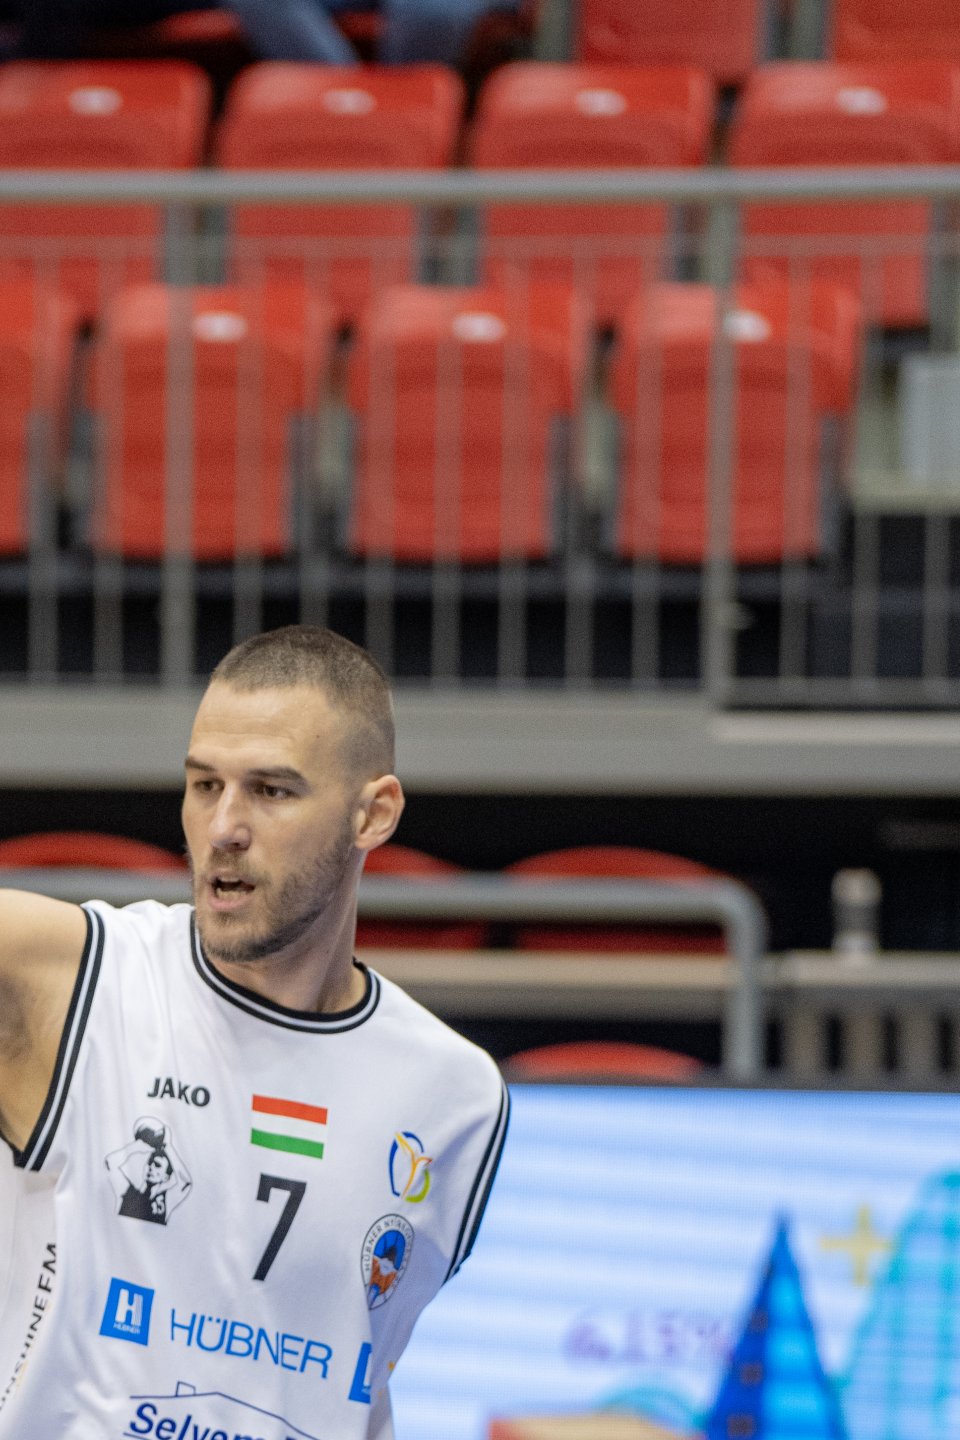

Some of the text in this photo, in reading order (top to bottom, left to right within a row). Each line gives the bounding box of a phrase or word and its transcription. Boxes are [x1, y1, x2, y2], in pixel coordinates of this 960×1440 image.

[147, 1077, 211, 1107] JAKO
[253, 1172, 307, 1281] 7
[168, 1307, 333, 1379] HÜBNER
